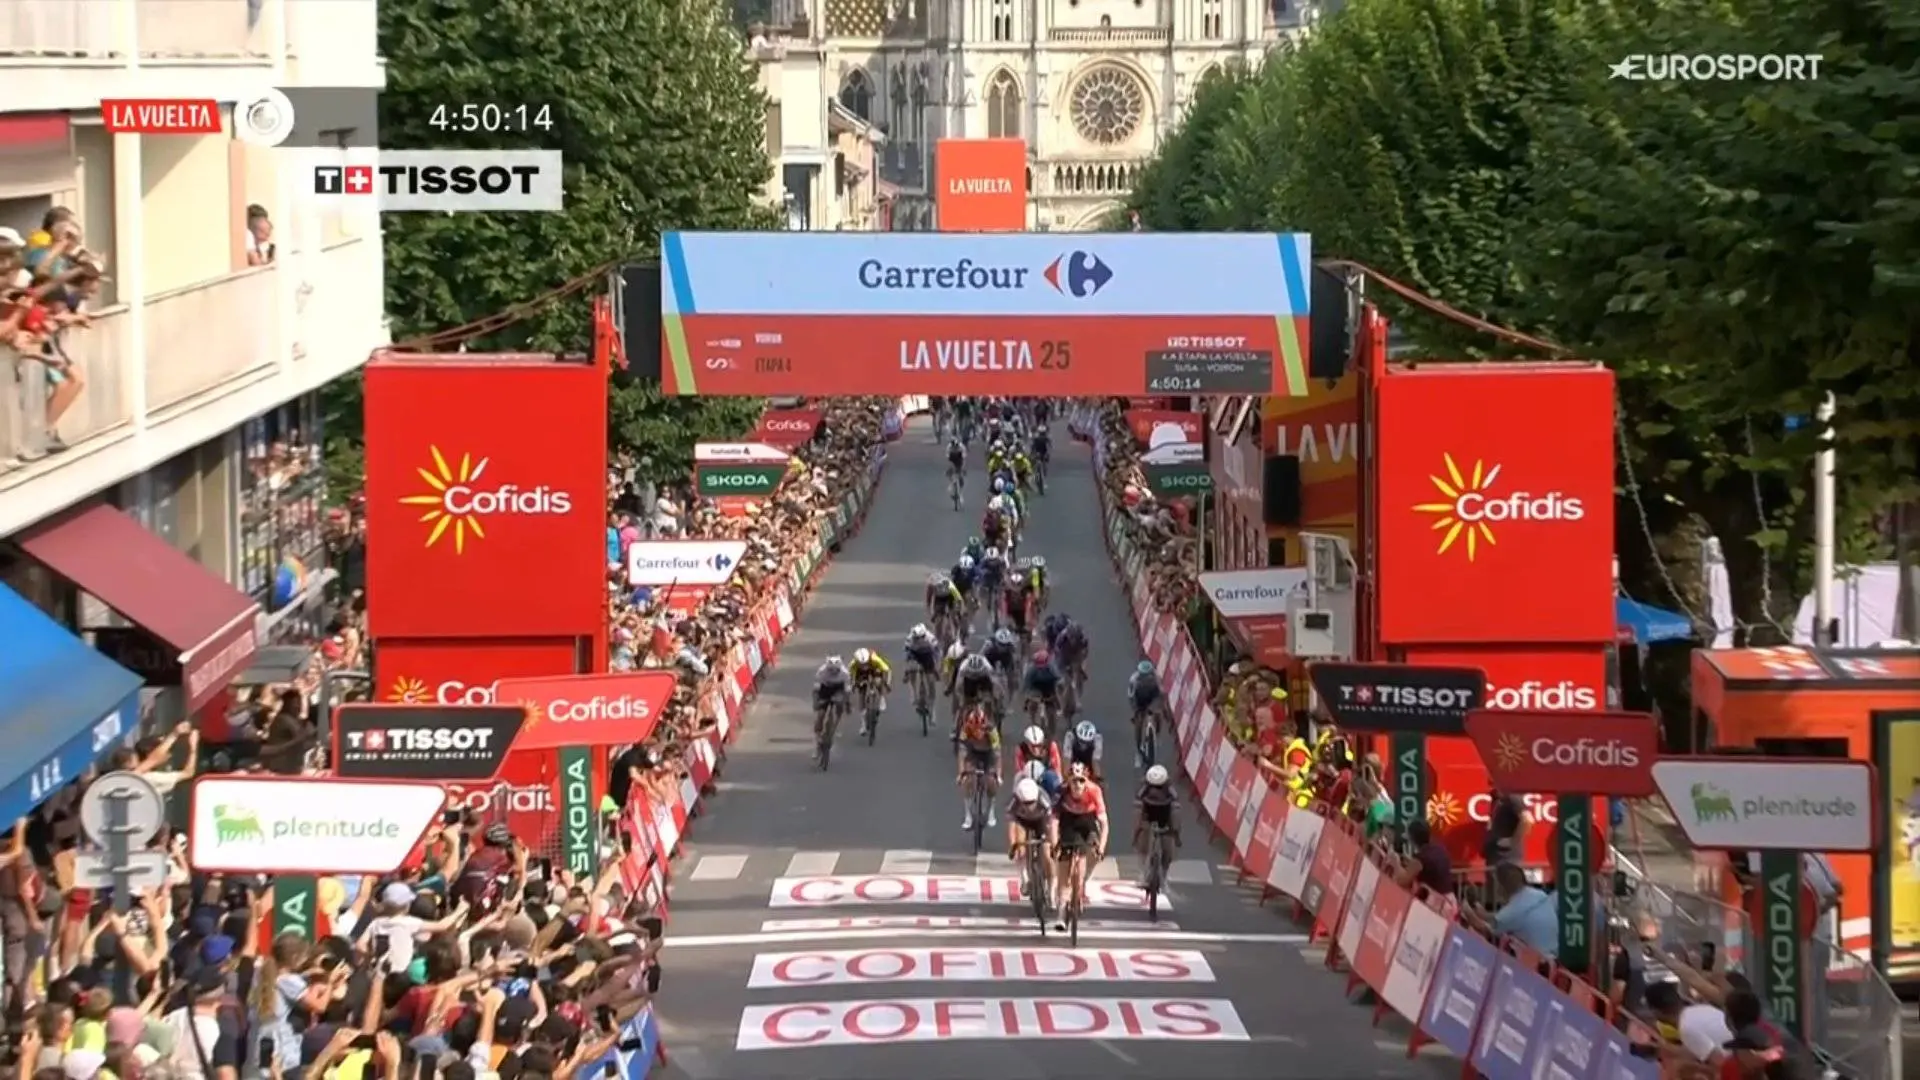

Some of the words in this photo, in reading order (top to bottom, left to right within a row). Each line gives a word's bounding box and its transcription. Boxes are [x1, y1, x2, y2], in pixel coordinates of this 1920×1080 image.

[950, 178, 965, 193] LA
[966, 178, 1012, 193] VUELTA
[859, 259, 1028, 289] Carrefour
[900, 340, 931, 370] LA
[936, 340, 1033, 370] VUELTA
[1040, 341, 1070, 370] 25
[1150, 377, 1201, 389] 4:50:14
[444, 484, 571, 513] Cofidis
[1456, 491, 1583, 521] Cofidis
[636, 557, 699, 569] Carrefour
[1215, 586, 1285, 601] Carrefour
[548, 694, 650, 724] Cofidis
[1376, 685, 1472, 707] TISSOT
[387, 728, 493, 750] TISSOT
[1532, 737, 1639, 767] Cofidis
[1743, 796, 1856, 819] plenitude
[273, 816, 400, 841] plenitude
[772, 950, 1191, 982] COFIDIS
[762, 998, 1221, 1045] COFIDIS
